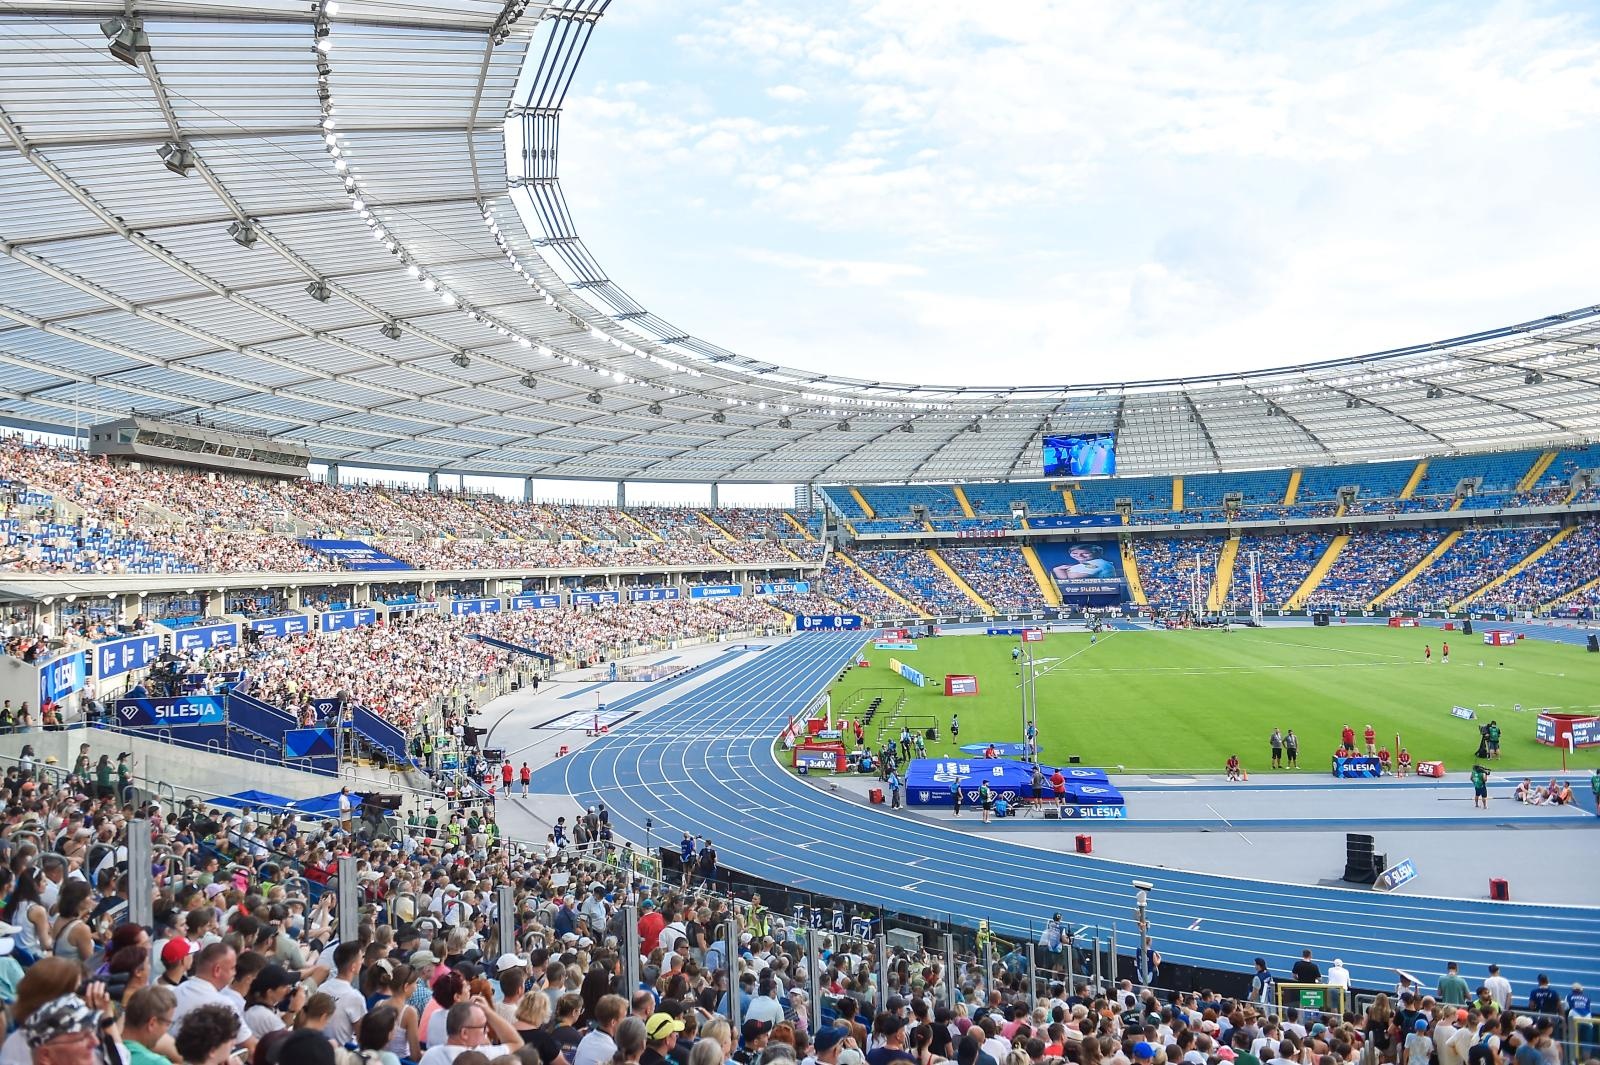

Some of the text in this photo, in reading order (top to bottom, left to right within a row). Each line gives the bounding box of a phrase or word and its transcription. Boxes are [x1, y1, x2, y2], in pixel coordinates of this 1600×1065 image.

[773, 584, 798, 592] SILESIA
[155, 703, 216, 718] SILESIA
[1343, 764, 1376, 772] SILESIA
[1080, 807, 1122, 817] SILESIA
[1391, 864, 1413, 884] SILESIA
[835, 917, 843, 929] 4
